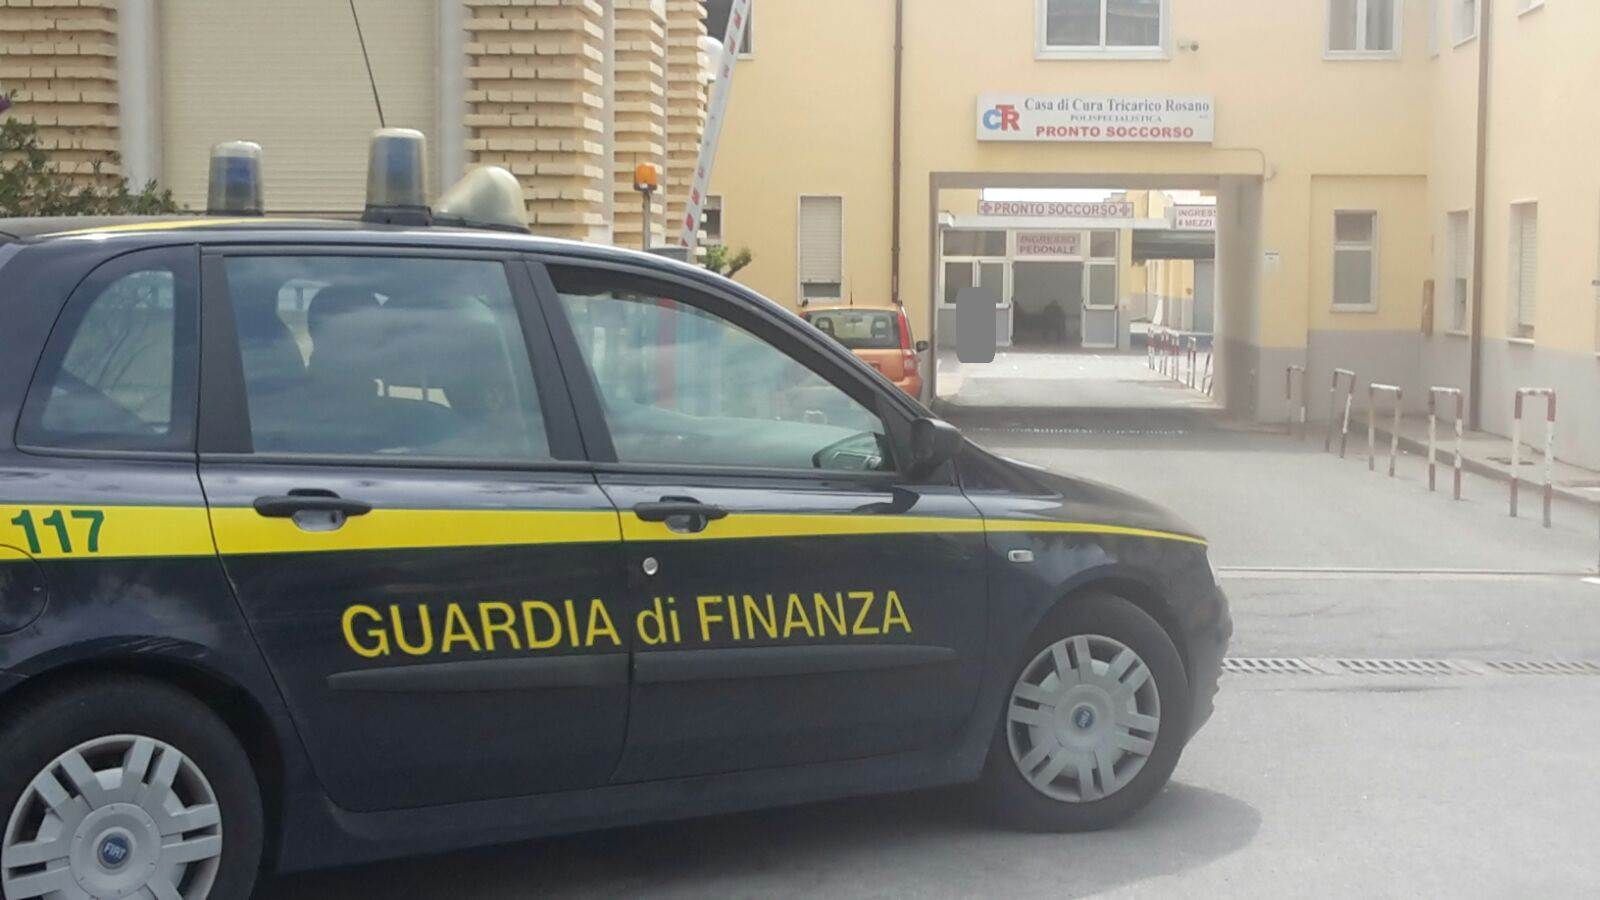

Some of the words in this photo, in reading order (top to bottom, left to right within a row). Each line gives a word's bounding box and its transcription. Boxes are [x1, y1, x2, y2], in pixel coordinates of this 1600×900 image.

[1024, 97, 1053, 111] Casa
[1057, 97, 1069, 111] di
[1072, 98, 1103, 112] Cura
[1107, 98, 1162, 112] Tricarico
[1165, 99, 1209, 112] Rosano
[982, 104, 1021, 131] CTR
[1070, 114, 1162, 122] POLISPECIALISTICA
[1036, 126, 1100, 137] PRONTO
[1106, 126, 1194, 138] SOCCORSO
[994, 203, 1045, 215] PRONTO
[1048, 203, 1117, 216] SOCCORSO
[1184, 219, 1212, 227] MEZZI
[1019, 245, 1076, 255] PEDONALE
[11, 509, 105, 554] 117
[340, 597, 622, 658] GUARDIA
[636, 596, 680, 645] di
[696, 588, 913, 641] FINANZA
[103, 842, 127, 859] FIAT
